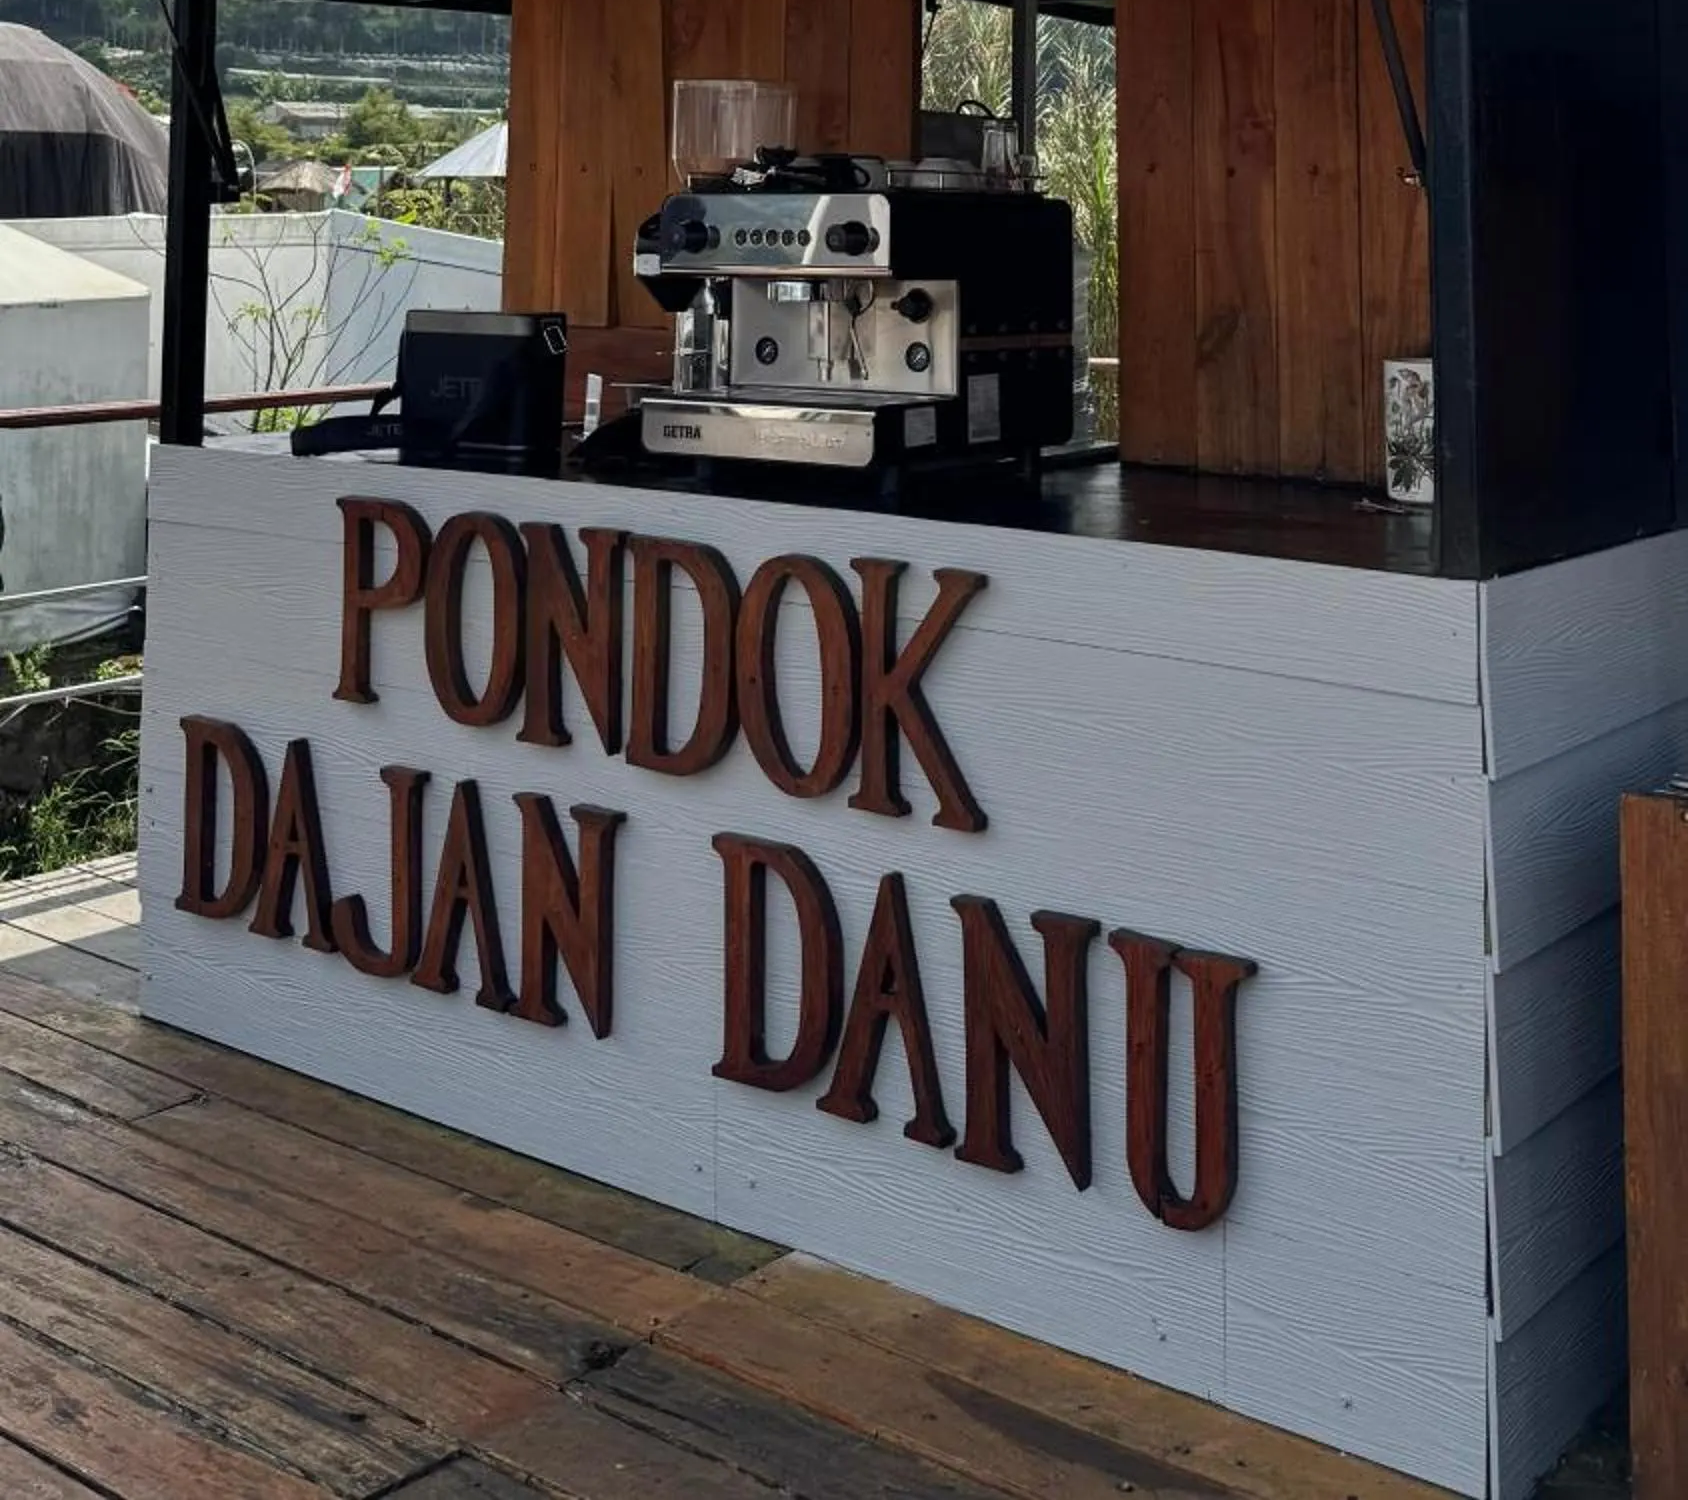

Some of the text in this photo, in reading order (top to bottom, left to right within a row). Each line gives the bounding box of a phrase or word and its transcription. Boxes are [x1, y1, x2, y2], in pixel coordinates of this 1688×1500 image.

[663, 424, 702, 439] GETRA
[333, 496, 988, 834] PONDOK
[175, 715, 1259, 1232] DAJAN DANU
